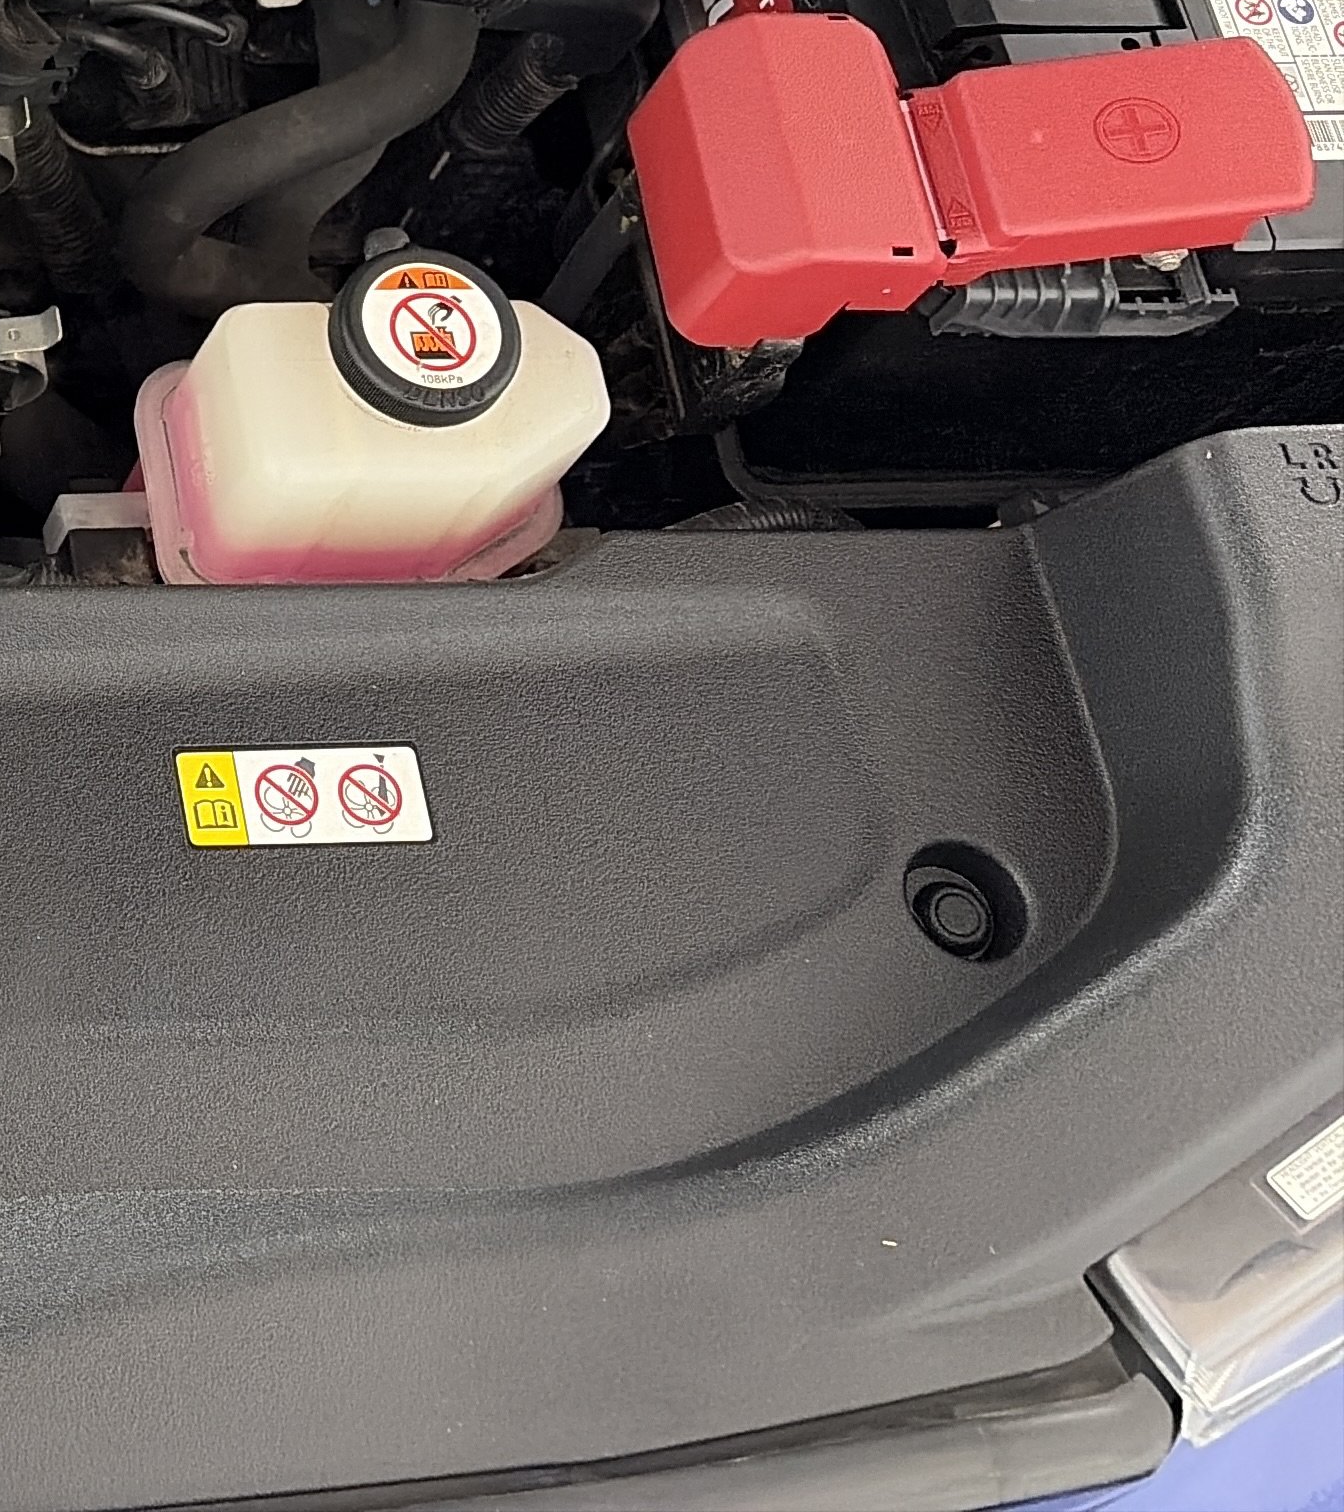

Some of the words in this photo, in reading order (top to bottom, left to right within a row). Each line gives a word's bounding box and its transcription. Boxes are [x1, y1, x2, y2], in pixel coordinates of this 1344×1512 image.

[1216, 4, 1229, 18] NOT
[1270, 26, 1283, 44] KEEP
[1265, 38, 1276, 50] THE
[1276, 43, 1289, 58] OUT
[1300, 58, 1316, 82] SEVERE
[1320, 58, 1333, 73] CAN
[1327, 73, 1342, 94] CAUSE
[421, 374, 463, 384] 108kPa
